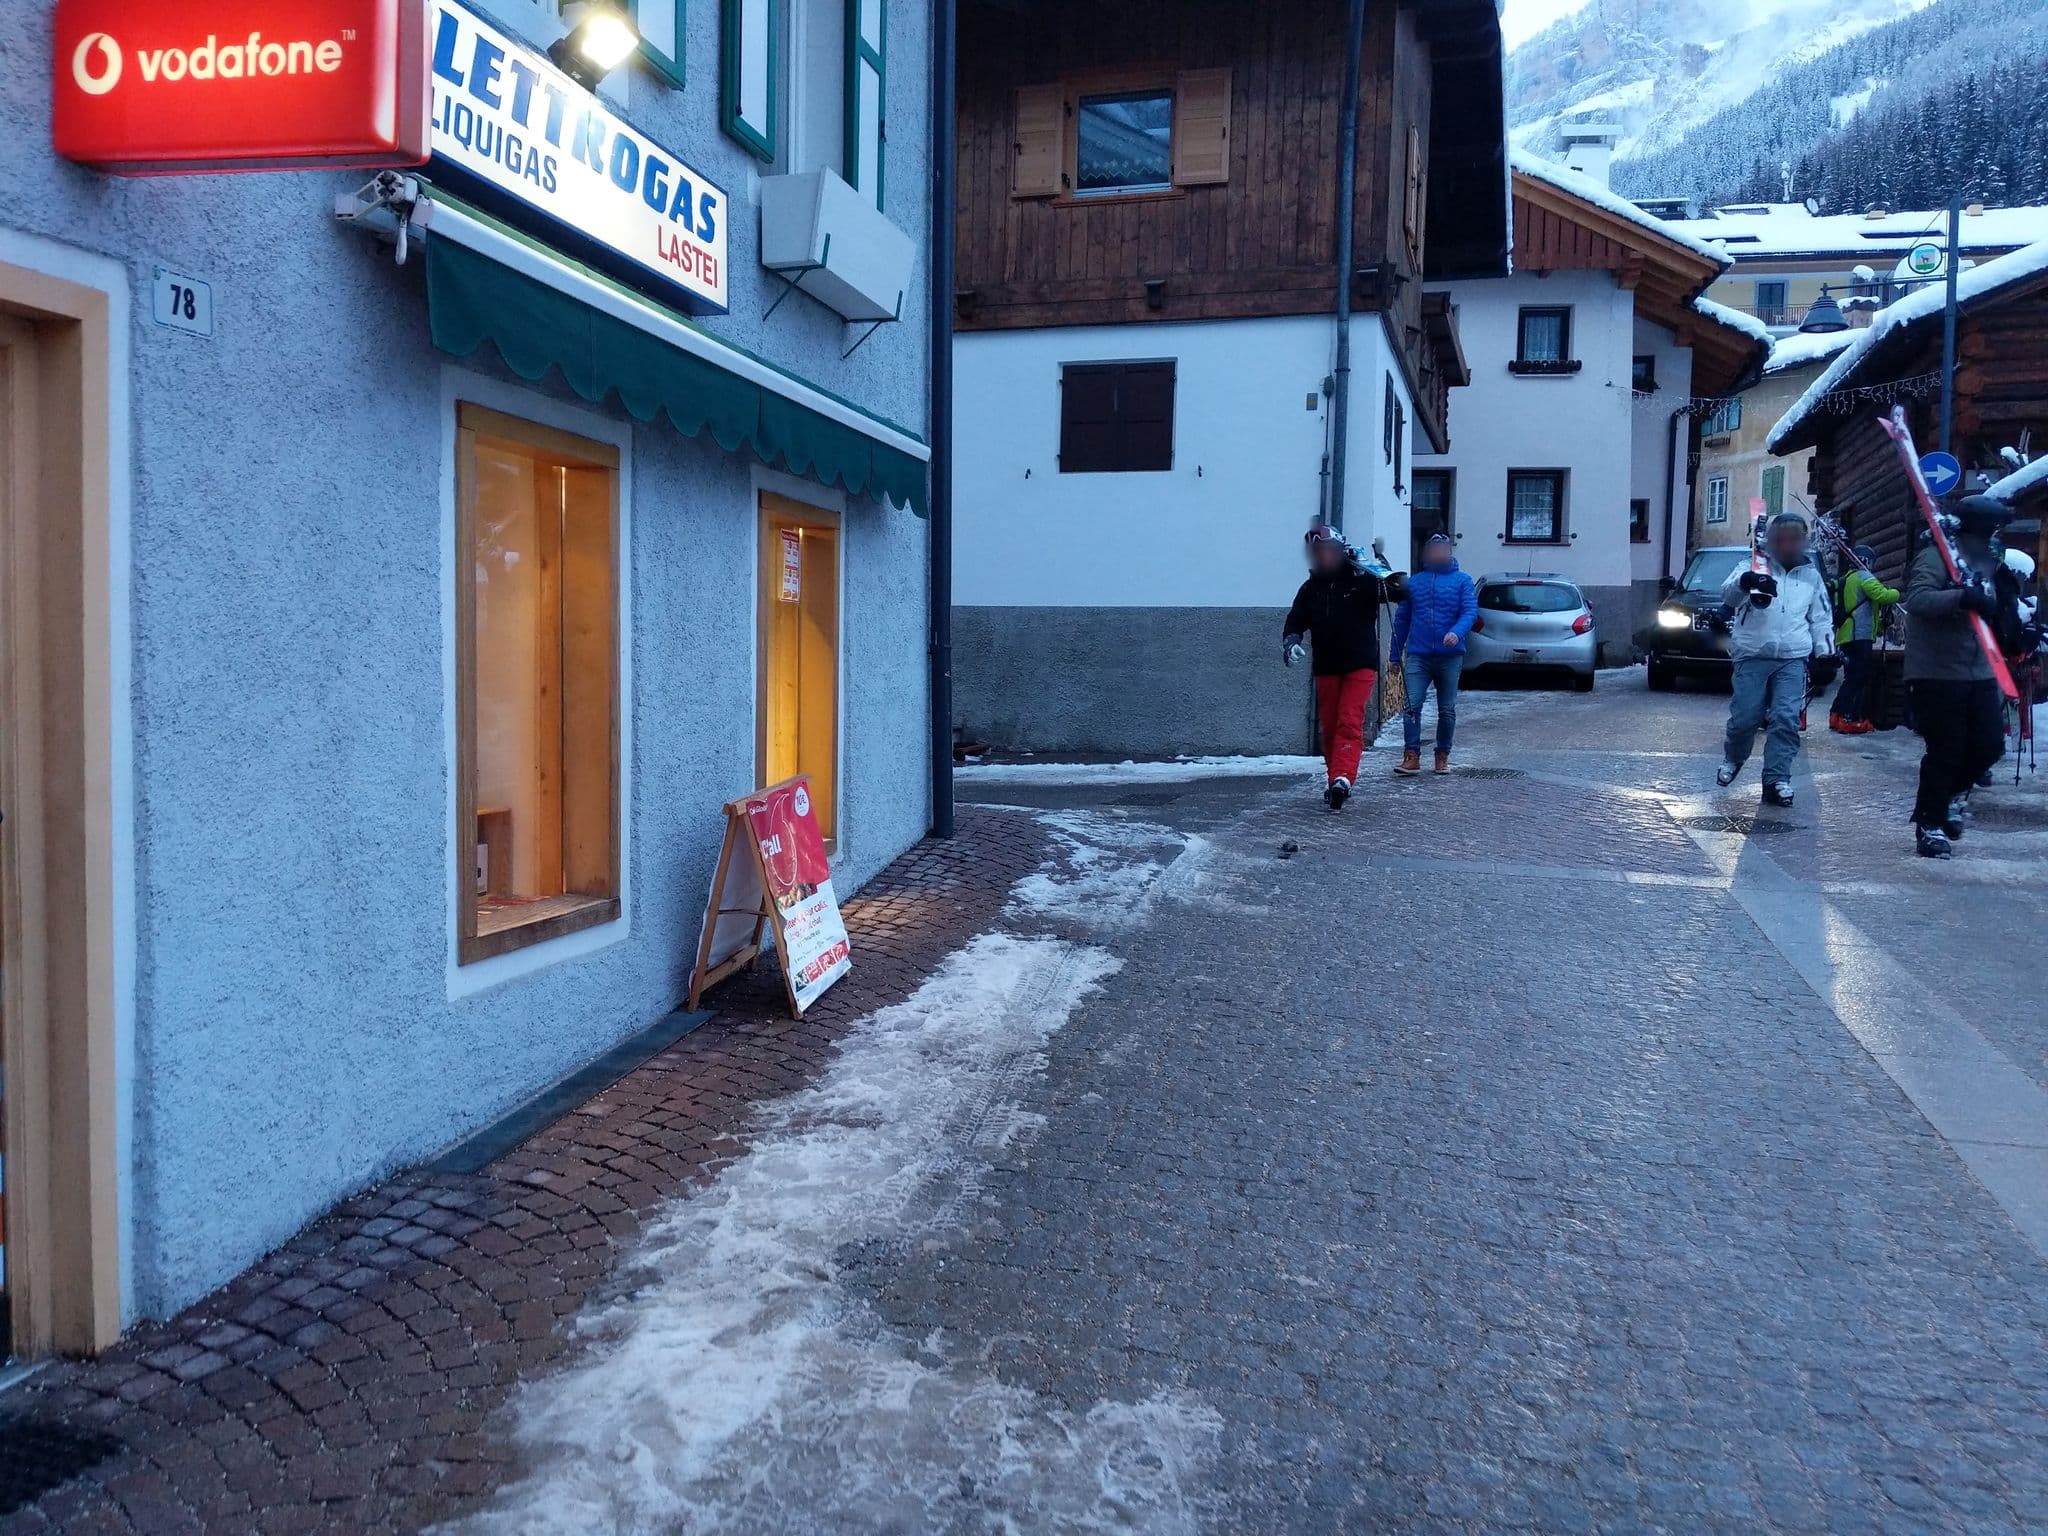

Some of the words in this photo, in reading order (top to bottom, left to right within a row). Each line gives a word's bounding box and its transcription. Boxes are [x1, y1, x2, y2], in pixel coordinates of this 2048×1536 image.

[137, 31, 343, 82] vodafone
[431, 86, 558, 194] LIQUIGAS
[657, 224, 718, 289] LASTEI
[170, 284, 196, 320] 78
